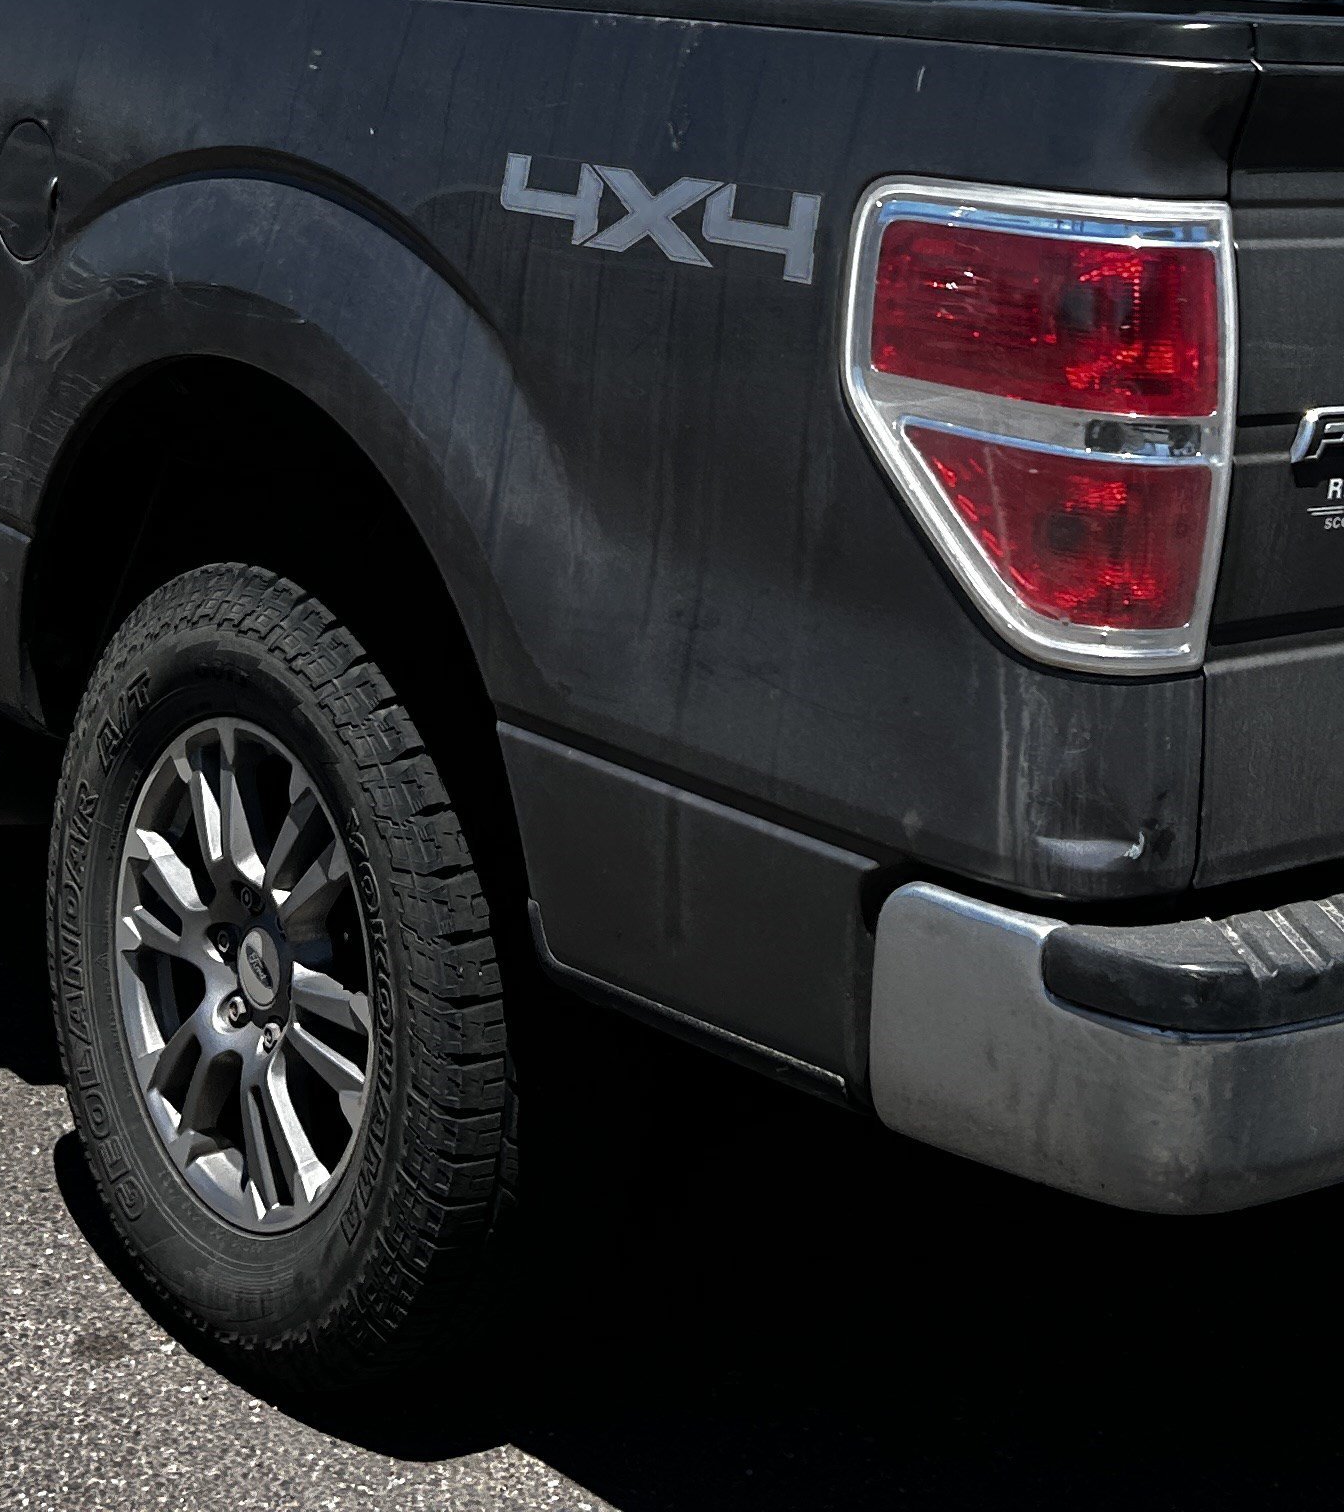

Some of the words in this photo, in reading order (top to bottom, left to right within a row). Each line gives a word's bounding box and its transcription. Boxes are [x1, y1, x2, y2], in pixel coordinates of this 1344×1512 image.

[500, 152, 821, 285] 4X4
[96, 666, 153, 776] A/T
[57, 780, 149, 1223] GEOLANDAR
[340, 806, 396, 1246] YOKOHAMA
